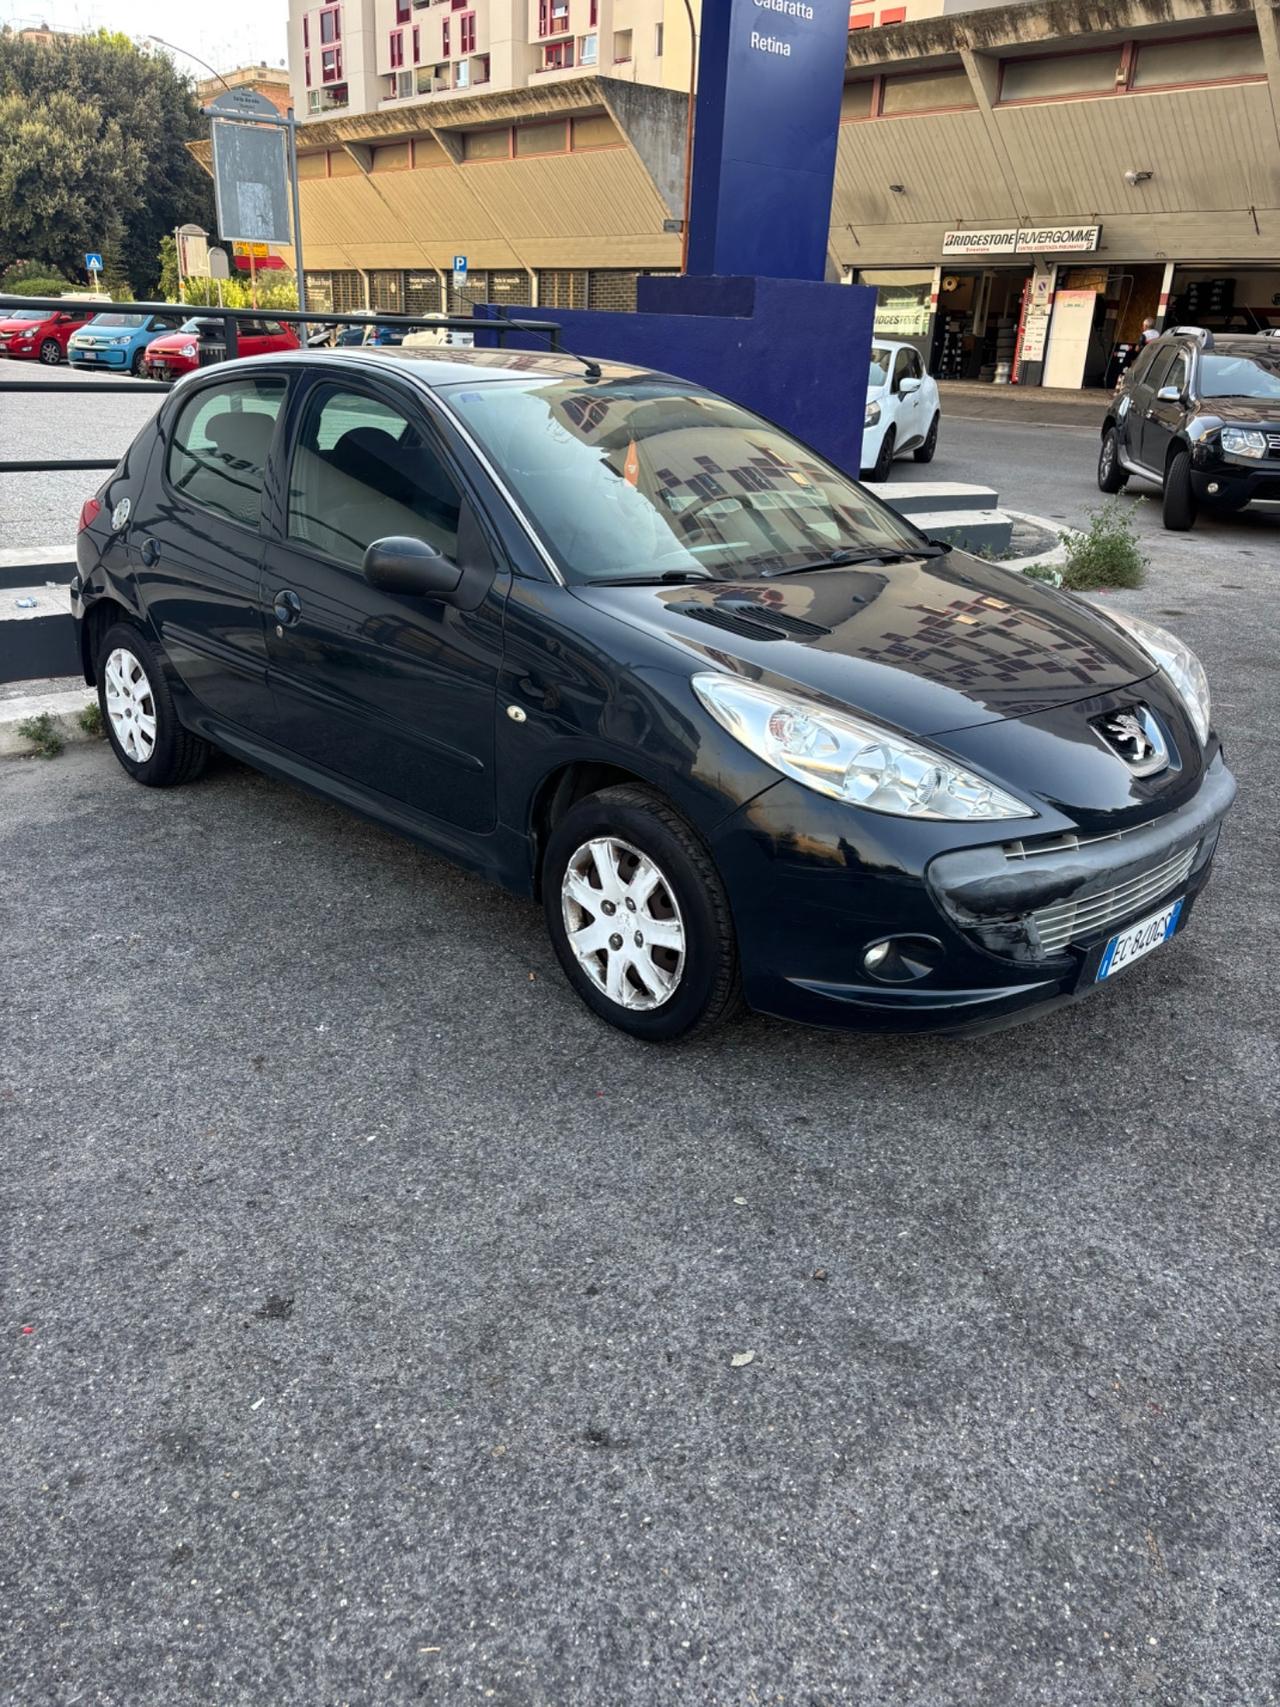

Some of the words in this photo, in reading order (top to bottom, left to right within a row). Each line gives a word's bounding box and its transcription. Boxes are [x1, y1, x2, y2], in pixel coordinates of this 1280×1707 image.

[750, 31, 791, 57] Retina
[945, 233, 1016, 246] BRIDGESTONE
[1018, 229, 1095, 244] RUVERGOMME
[456, 257, 465, 270] P
